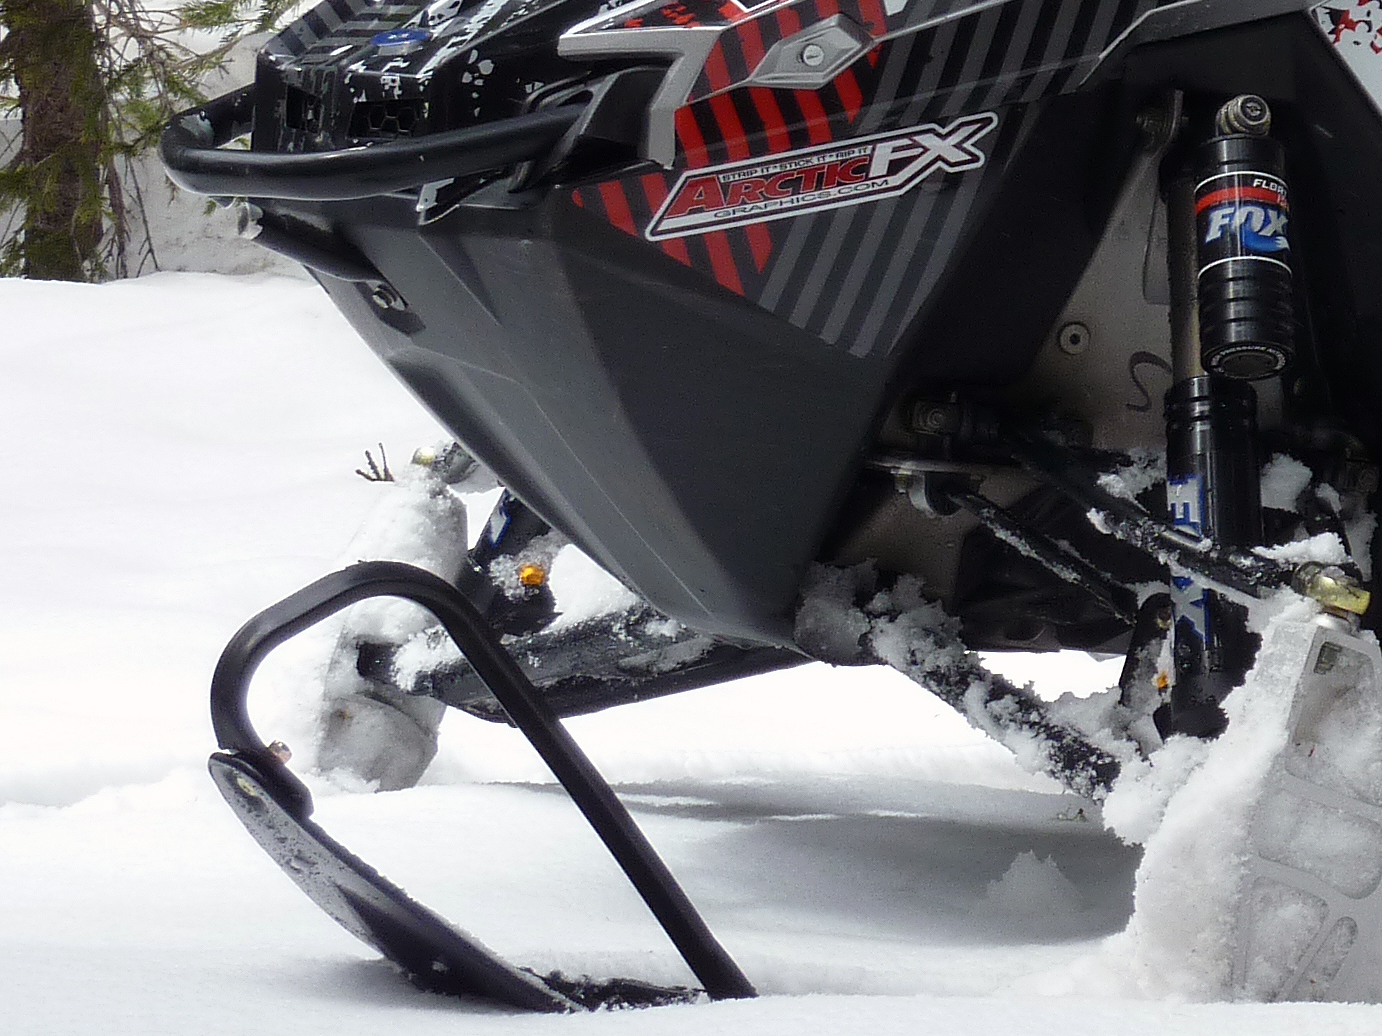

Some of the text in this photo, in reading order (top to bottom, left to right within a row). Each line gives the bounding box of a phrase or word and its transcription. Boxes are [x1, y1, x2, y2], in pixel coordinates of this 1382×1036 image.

[722, 170, 757, 182] STRIP
[714, 179, 889, 219] GRAPHICS.COM
[1205, 205, 1289, 245] FOX
